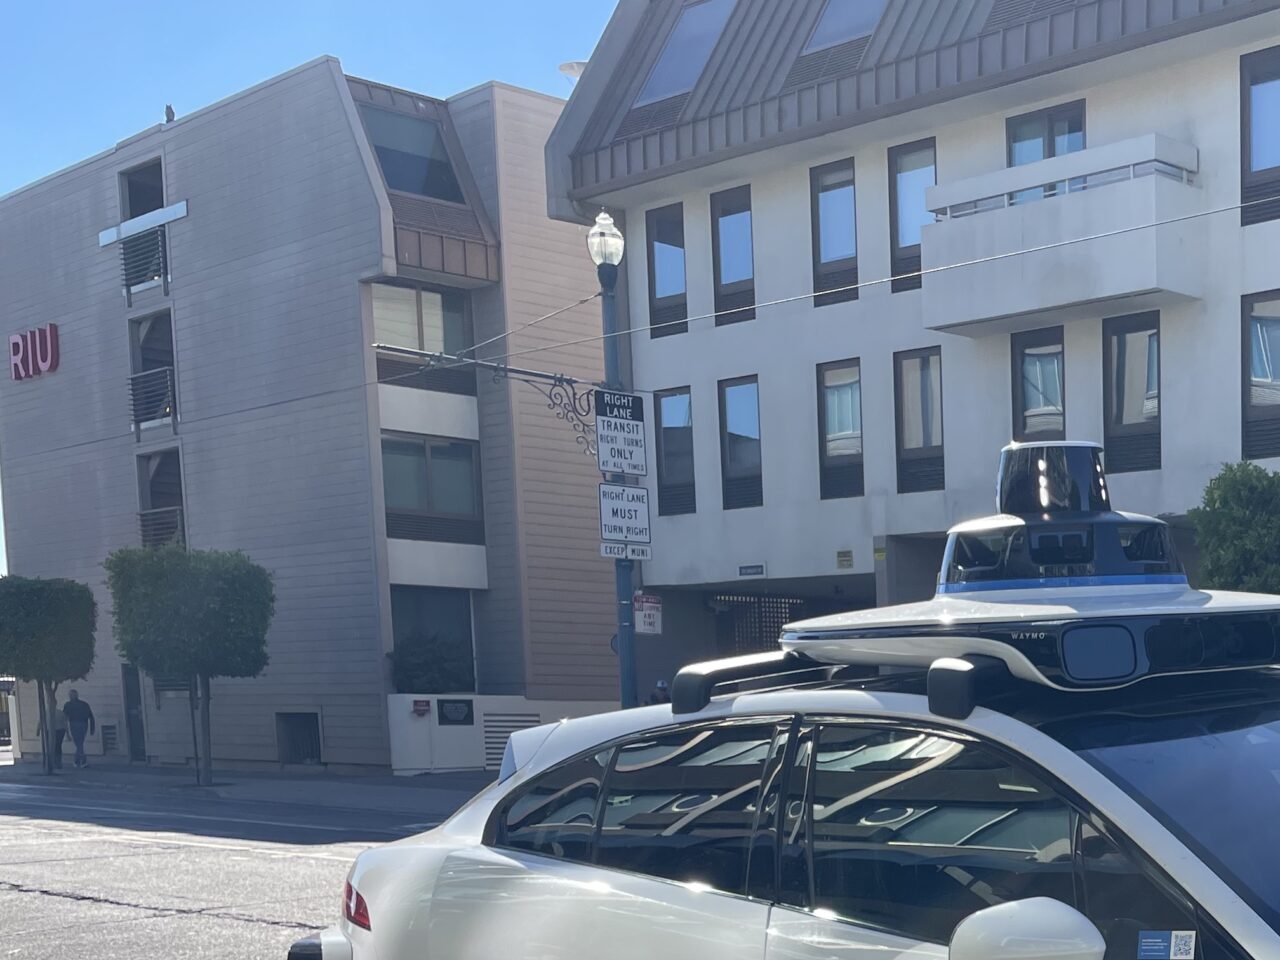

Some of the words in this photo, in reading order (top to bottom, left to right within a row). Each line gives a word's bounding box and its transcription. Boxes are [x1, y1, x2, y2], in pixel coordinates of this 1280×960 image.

[9, 322, 59, 380] RIU
[604, 393, 633, 407] RIGHT
[606, 406, 633, 419] LANE
[601, 419, 640, 435] TRANSIT
[599, 434, 618, 445] RIGHT
[623, 436, 643, 448] TURNS
[610, 447, 634, 460] ONLY
[601, 460, 609, 468] AT
[613, 461, 623, 470] ALL
[628, 462, 645, 472] TIMES
[602, 490, 625, 502] RIGHT
[626, 493, 646, 504] LANE
[611, 507, 638, 520] MUST
[603, 523, 624, 535] TURN
[626, 525, 648, 537] RIGHT
[631, 547, 648, 558] MUNI
[1010, 631, 1046, 640] WAYMO
